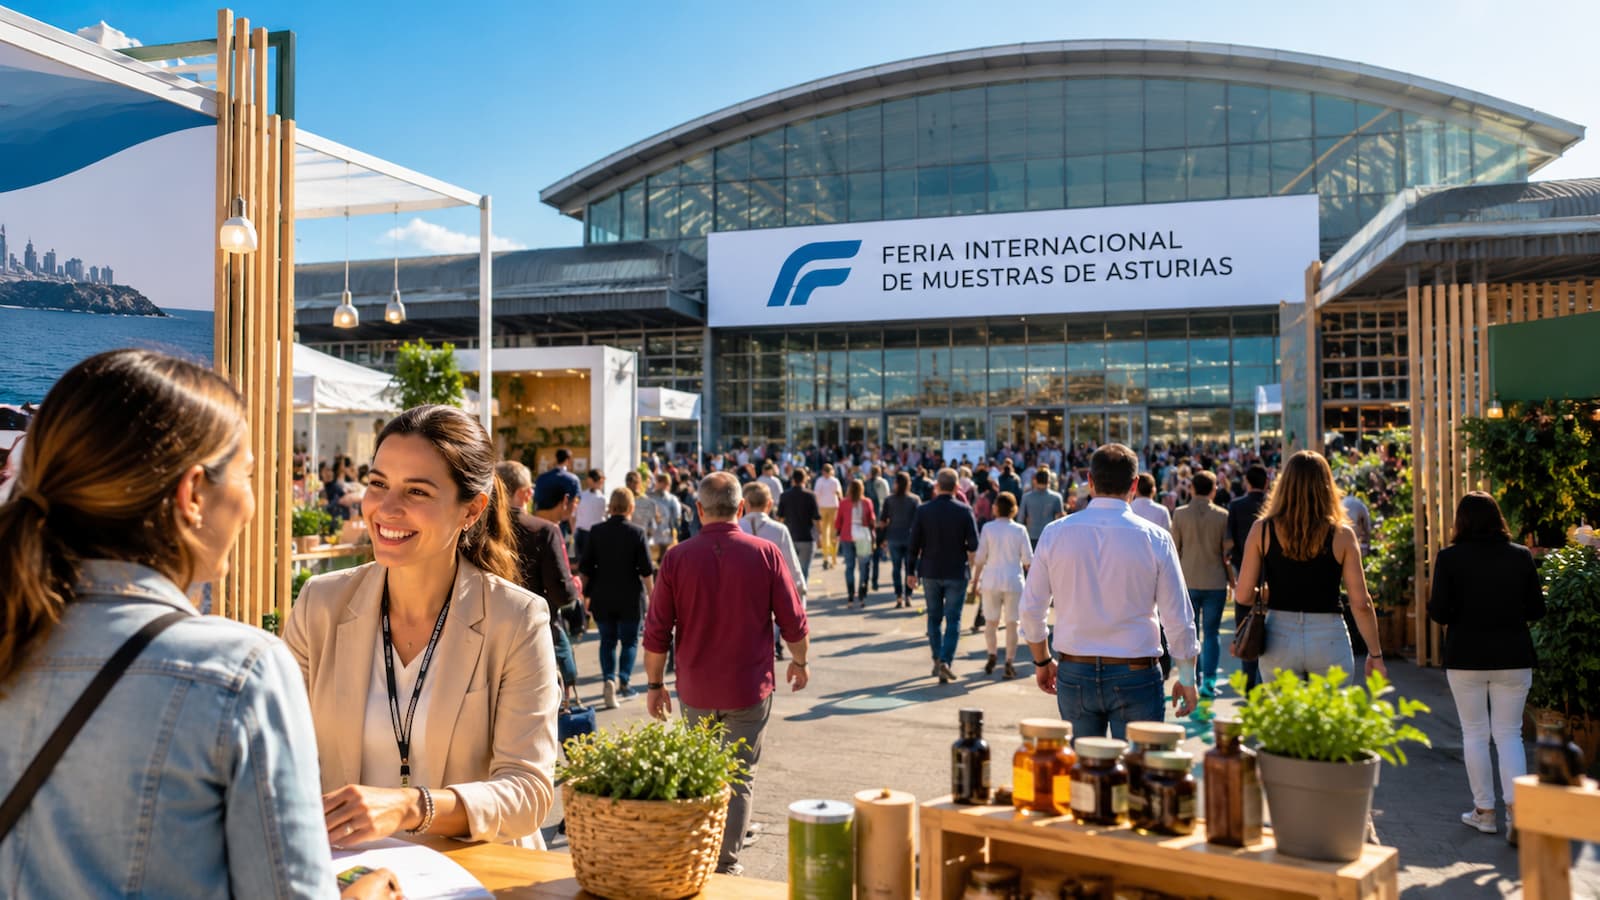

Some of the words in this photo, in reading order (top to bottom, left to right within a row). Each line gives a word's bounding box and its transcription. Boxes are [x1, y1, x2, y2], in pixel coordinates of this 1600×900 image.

[882, 243, 955, 265] FERIA
[965, 231, 1183, 260] INTERNACIONAL
[882, 272, 913, 292] DE
[922, 266, 1054, 290] MUESTRAS
[1064, 263, 1097, 284] DE
[1105, 256, 1233, 282] ASTURIAS
